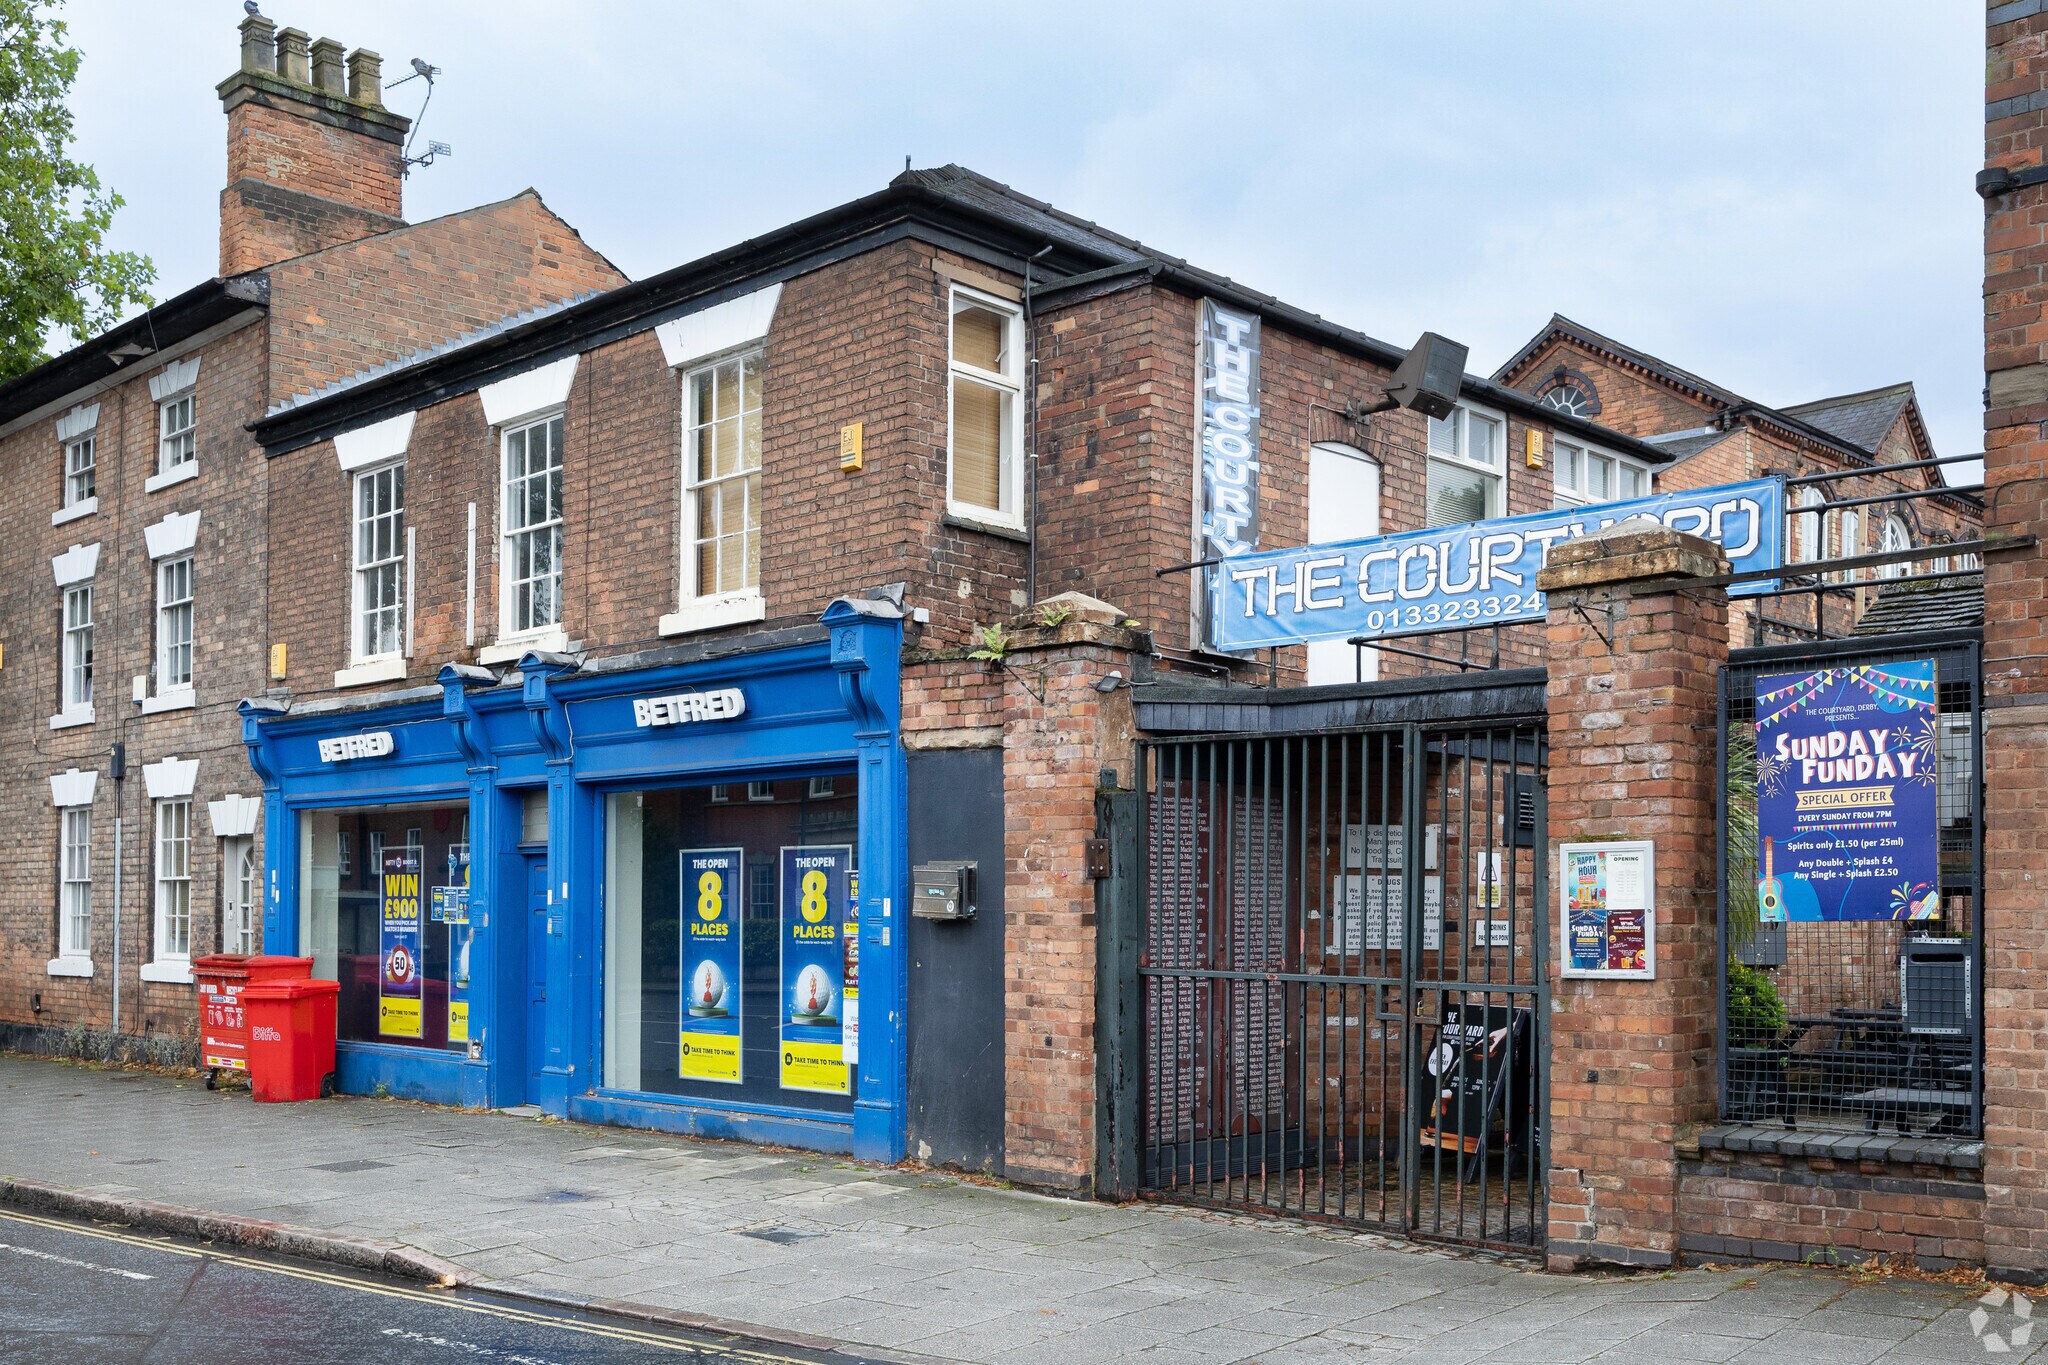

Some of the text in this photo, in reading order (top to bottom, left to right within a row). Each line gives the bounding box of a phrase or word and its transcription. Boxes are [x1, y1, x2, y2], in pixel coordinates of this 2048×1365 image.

[1214, 312, 1250, 403] THE
[1230, 498, 1761, 619] THE COURTRD
[633, 688, 746, 728] BETFRED
[1818, 706, 1856, 715] COURTYARD,
[1858, 704, 1880, 713] DERBY,
[1825, 713, 1860, 722] PRESENTS...
[318, 731, 394, 763] BETFRED
[1775, 729, 1890, 762] SUNDAY
[1802, 752, 1918, 785] FUNDAY
[1802, 791, 1886, 806] SPECIAL OFFER
[1798, 810, 1892, 822] EVERY SUNDAY FROM 7PM
[1788, 837, 1904, 852] Spirits only £1.50 (per 25ml)
[692, 858, 728, 868] THE OPEN
[796, 856, 836, 868] THE OPEN
[1577, 856, 1596, 864] HAPPY
[1798, 860, 1814, 870] Any
[1816, 858, 1844, 868] Double
[1854, 858, 1880, 866] Splash
[1882, 856, 1894, 864] £4
[1578, 865, 1598, 876] HOUR
[1794, 872, 1810, 881] Any
[1811, 870, 1836, 880] Single
[1846, 870, 1872, 878] Splash
[1874, 868, 1898, 877] £2.50
[385, 874, 418, 896] WIN
[698, 870, 722, 921] 8
[801, 870, 828, 923] 8
[385, 898, 418, 918] £900
[691, 923, 728, 936] PLACES
[794, 925, 835, 938] PLACES
[395, 957, 404, 970] 50
[1448, 1012, 1458, 1023] HE
[252, 1026, 280, 1040] Biffa
